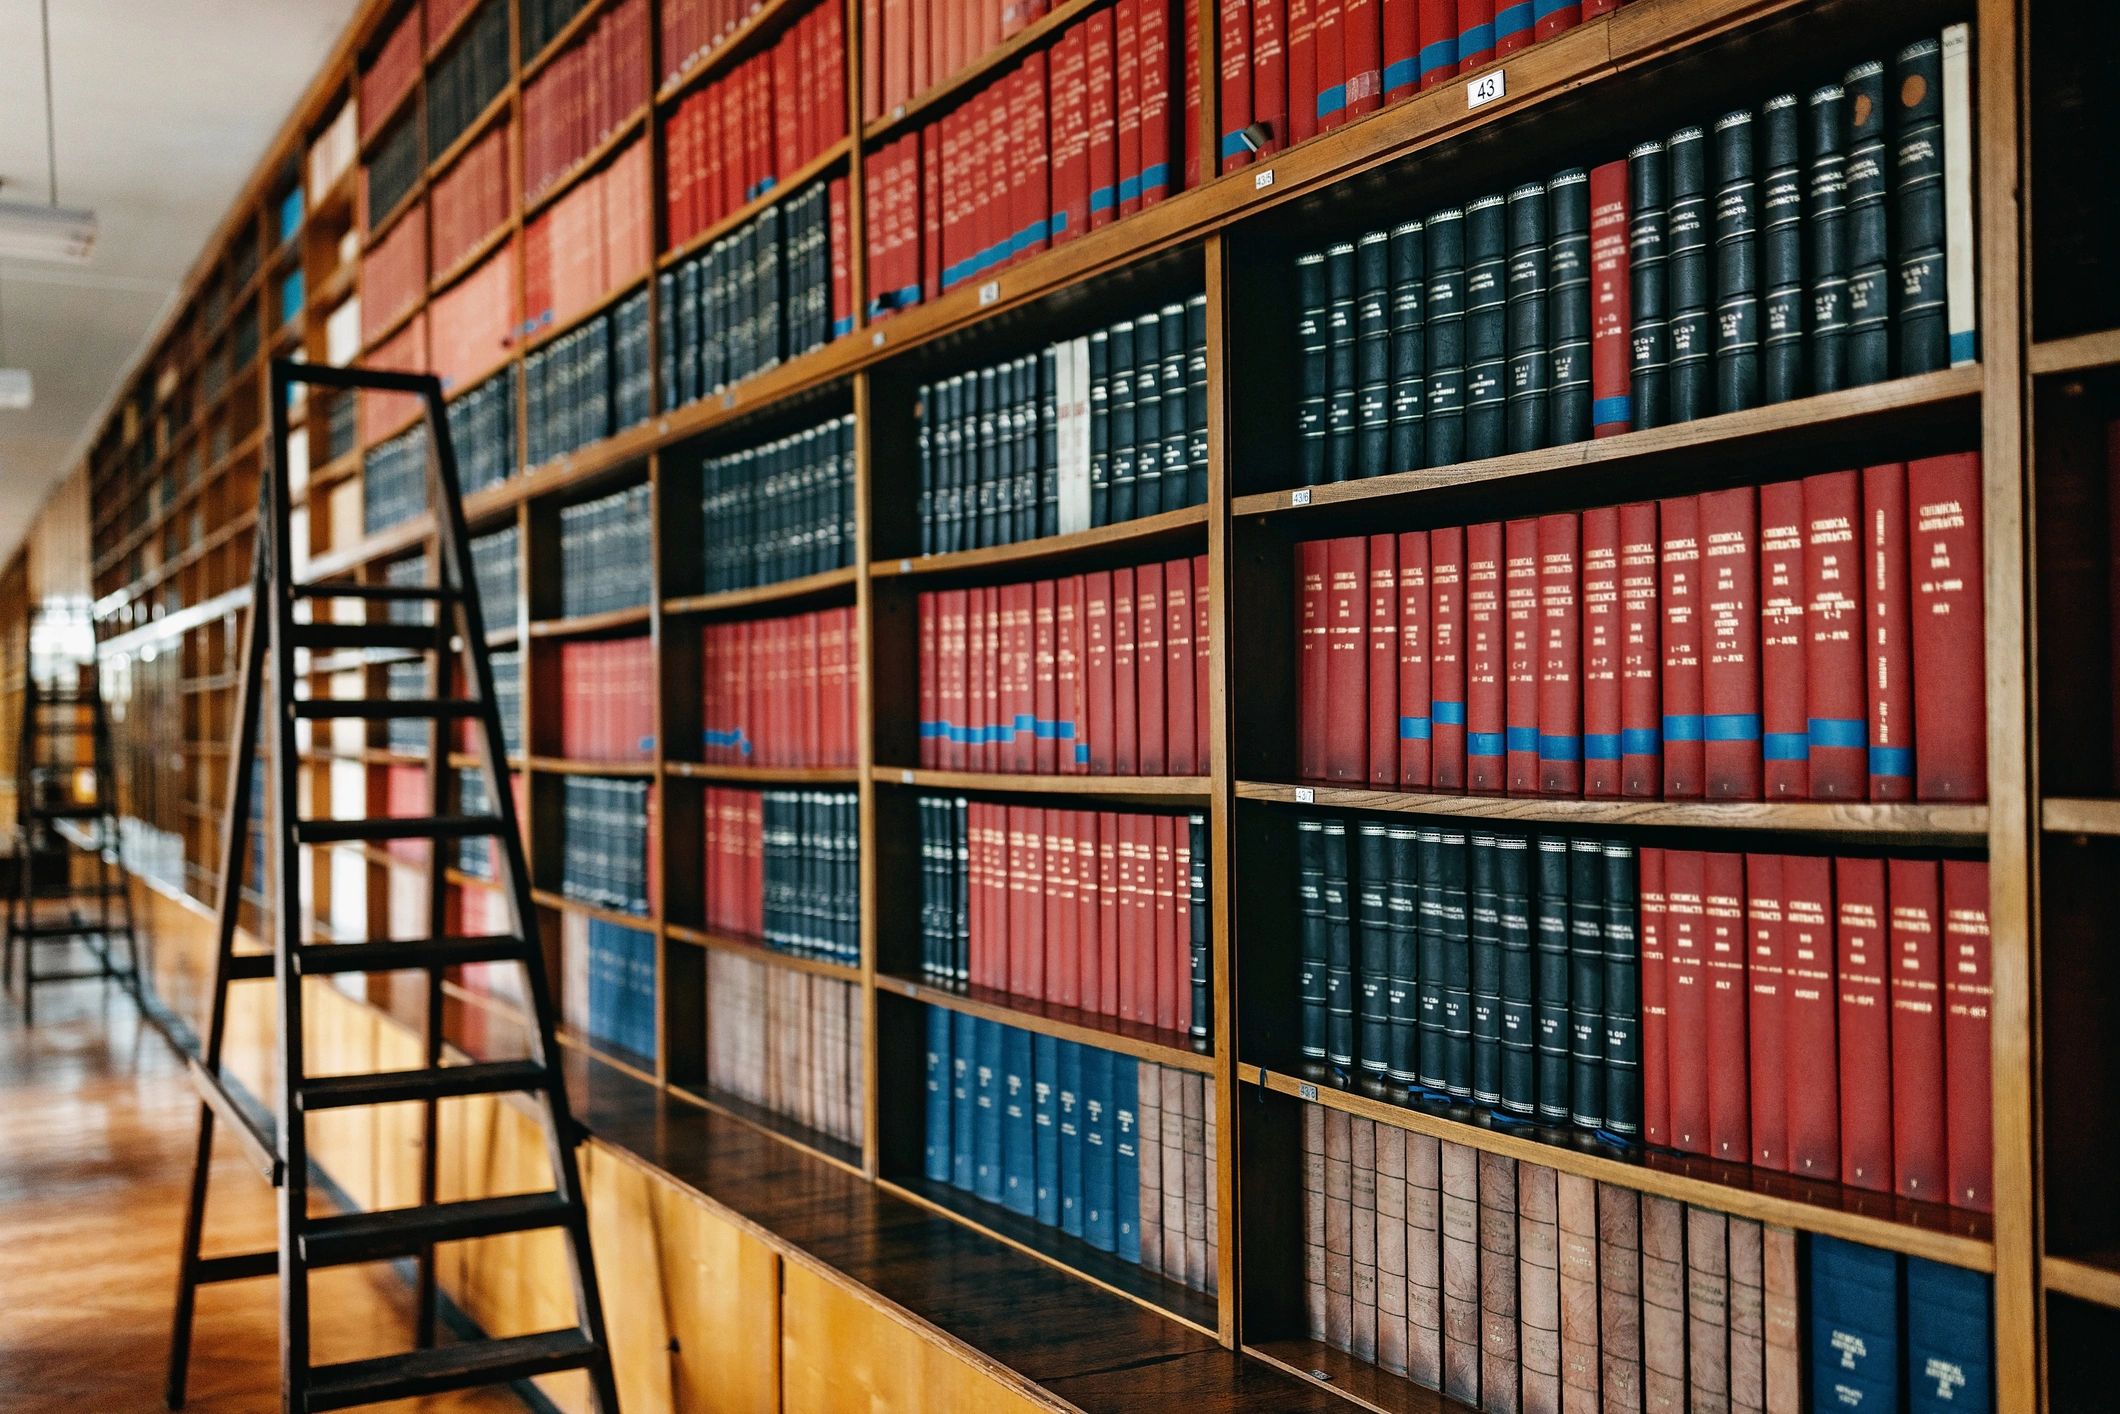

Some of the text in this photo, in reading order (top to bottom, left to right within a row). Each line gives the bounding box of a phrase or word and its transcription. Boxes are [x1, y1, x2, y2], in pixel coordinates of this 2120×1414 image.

[1478, 79, 1494, 99] 43
[1256, 174, 1272, 187] 43/5
[1294, 492, 1309, 503] 43/6
[1812, 517, 1850, 530] CHEMICAL
[1708, 531, 1744, 543] CHEMICAL
[1764, 526, 1799, 538] CHEMICAL
[1811, 530, 1852, 544] ABSTRACTS
[1708, 543, 1746, 556] ABSTRACTS
[1762, 538, 1801, 550] ABSTRACTS
